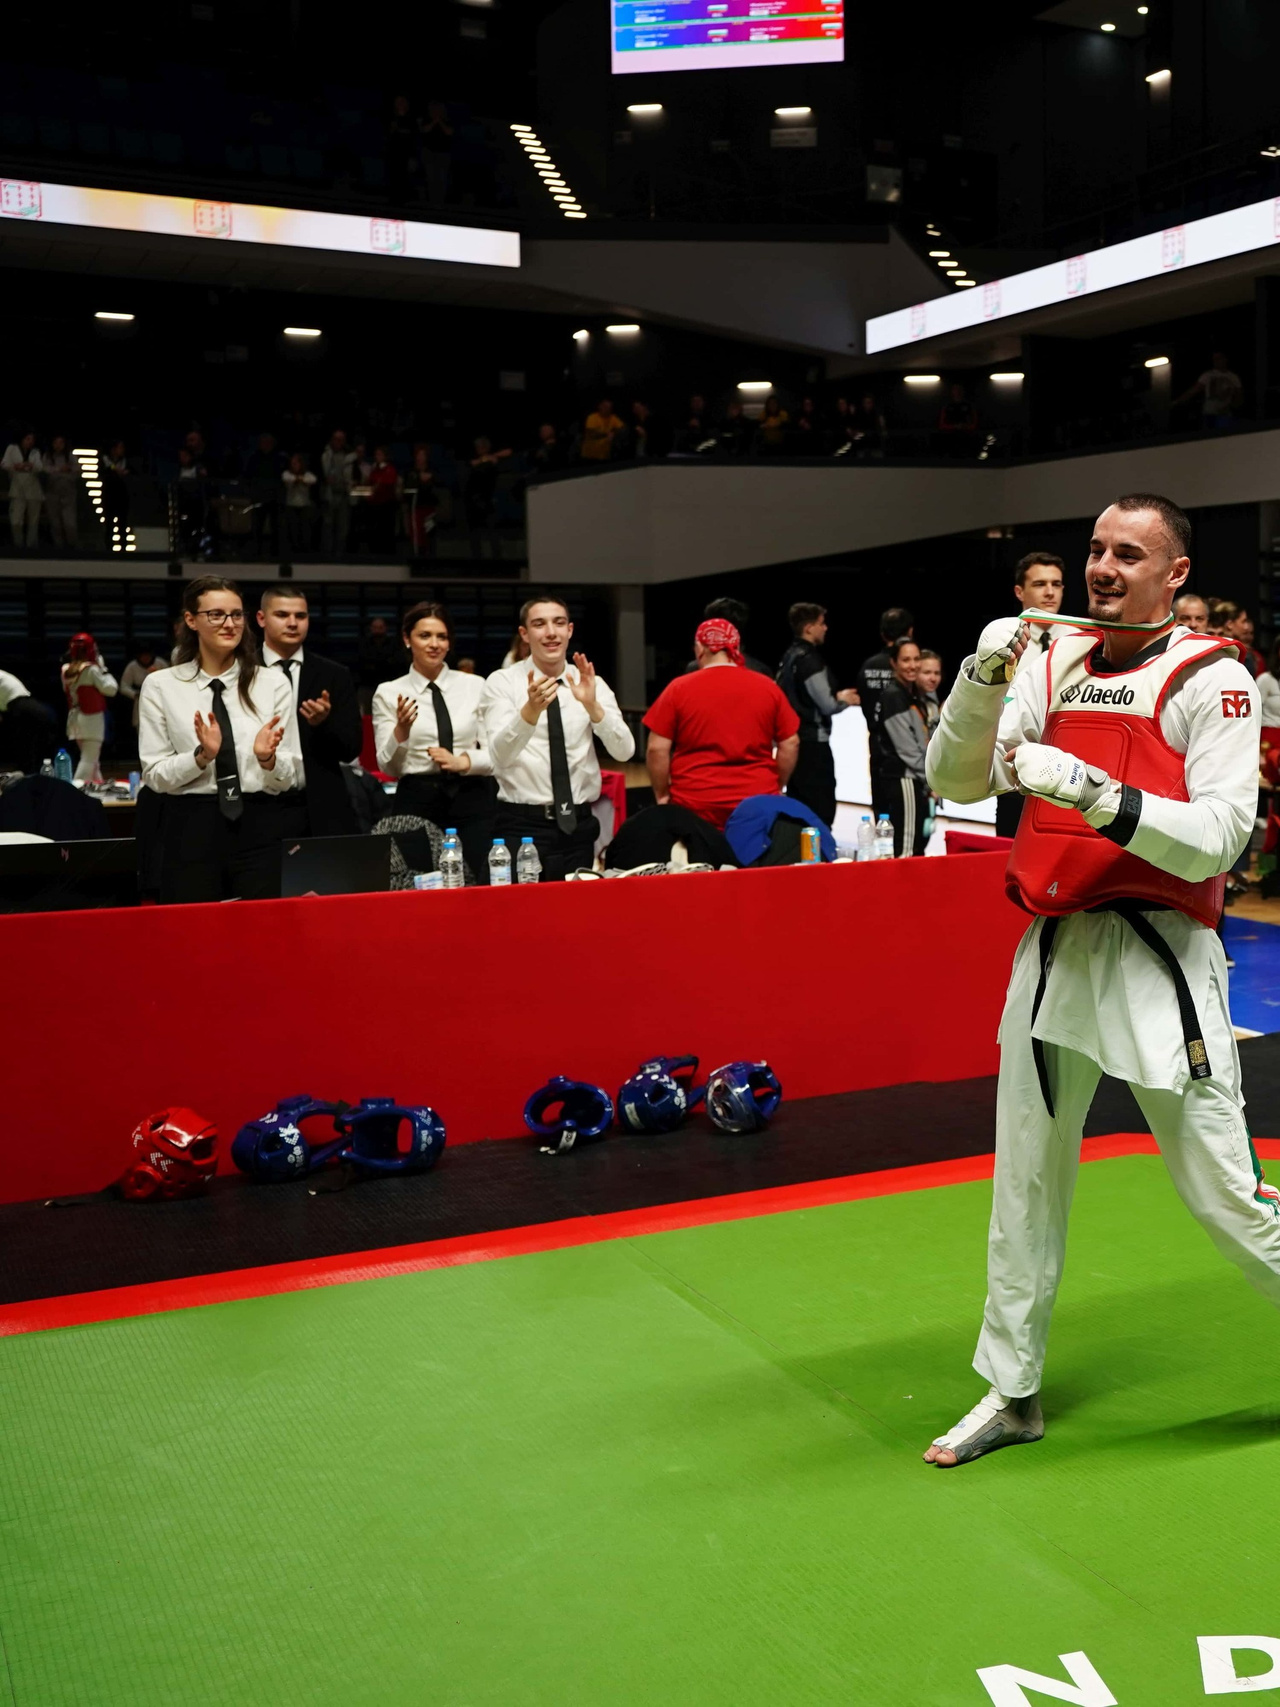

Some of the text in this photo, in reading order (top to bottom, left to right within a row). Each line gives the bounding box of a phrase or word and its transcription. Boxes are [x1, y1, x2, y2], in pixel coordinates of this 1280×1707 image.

[1080, 684, 1135, 706] Daedo
[1069, 762, 1081, 785] Daedo
[1046, 881, 1059, 898] 4
